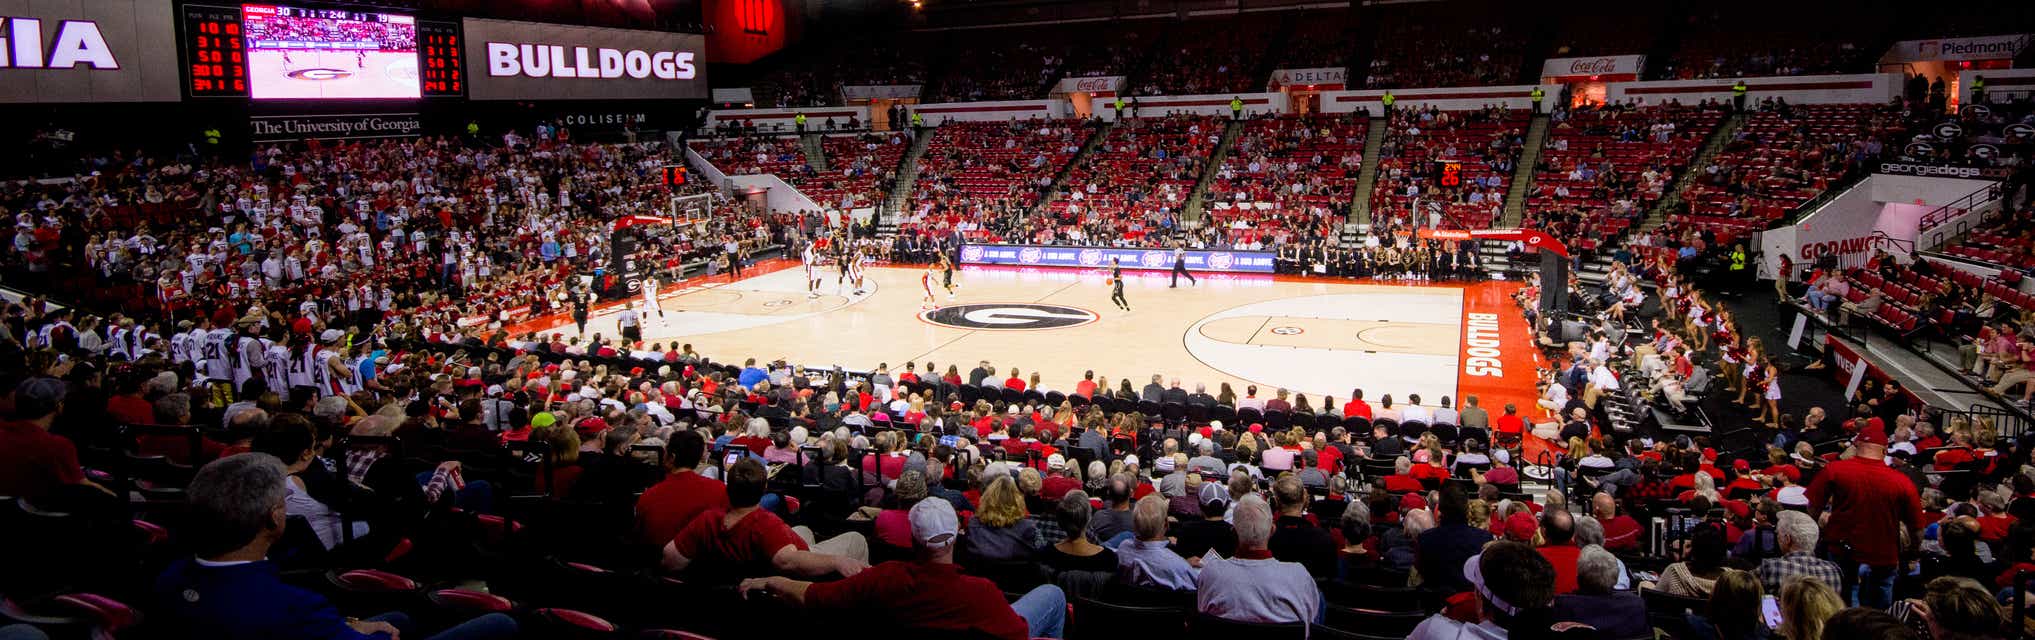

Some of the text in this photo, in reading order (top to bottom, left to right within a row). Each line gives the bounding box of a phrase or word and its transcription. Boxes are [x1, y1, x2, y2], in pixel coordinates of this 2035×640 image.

[246, 6, 275, 14] GEORGIA
[277, 7, 290, 16] 30
[330, 11, 346, 19] 2:44
[378, 14, 388, 22] 19
[0, 16, 120, 70] IA
[1942, 40, 2014, 54] Piedmont
[487, 42, 696, 79] BULLDOGS
[1296, 72, 1340, 81] DELTA
[251, 117, 420, 135] The University of Georgia
[1801, 242, 1827, 260] GO
[206, 342, 220, 359] 21
[1466, 312, 1503, 377] BULLDOGS
